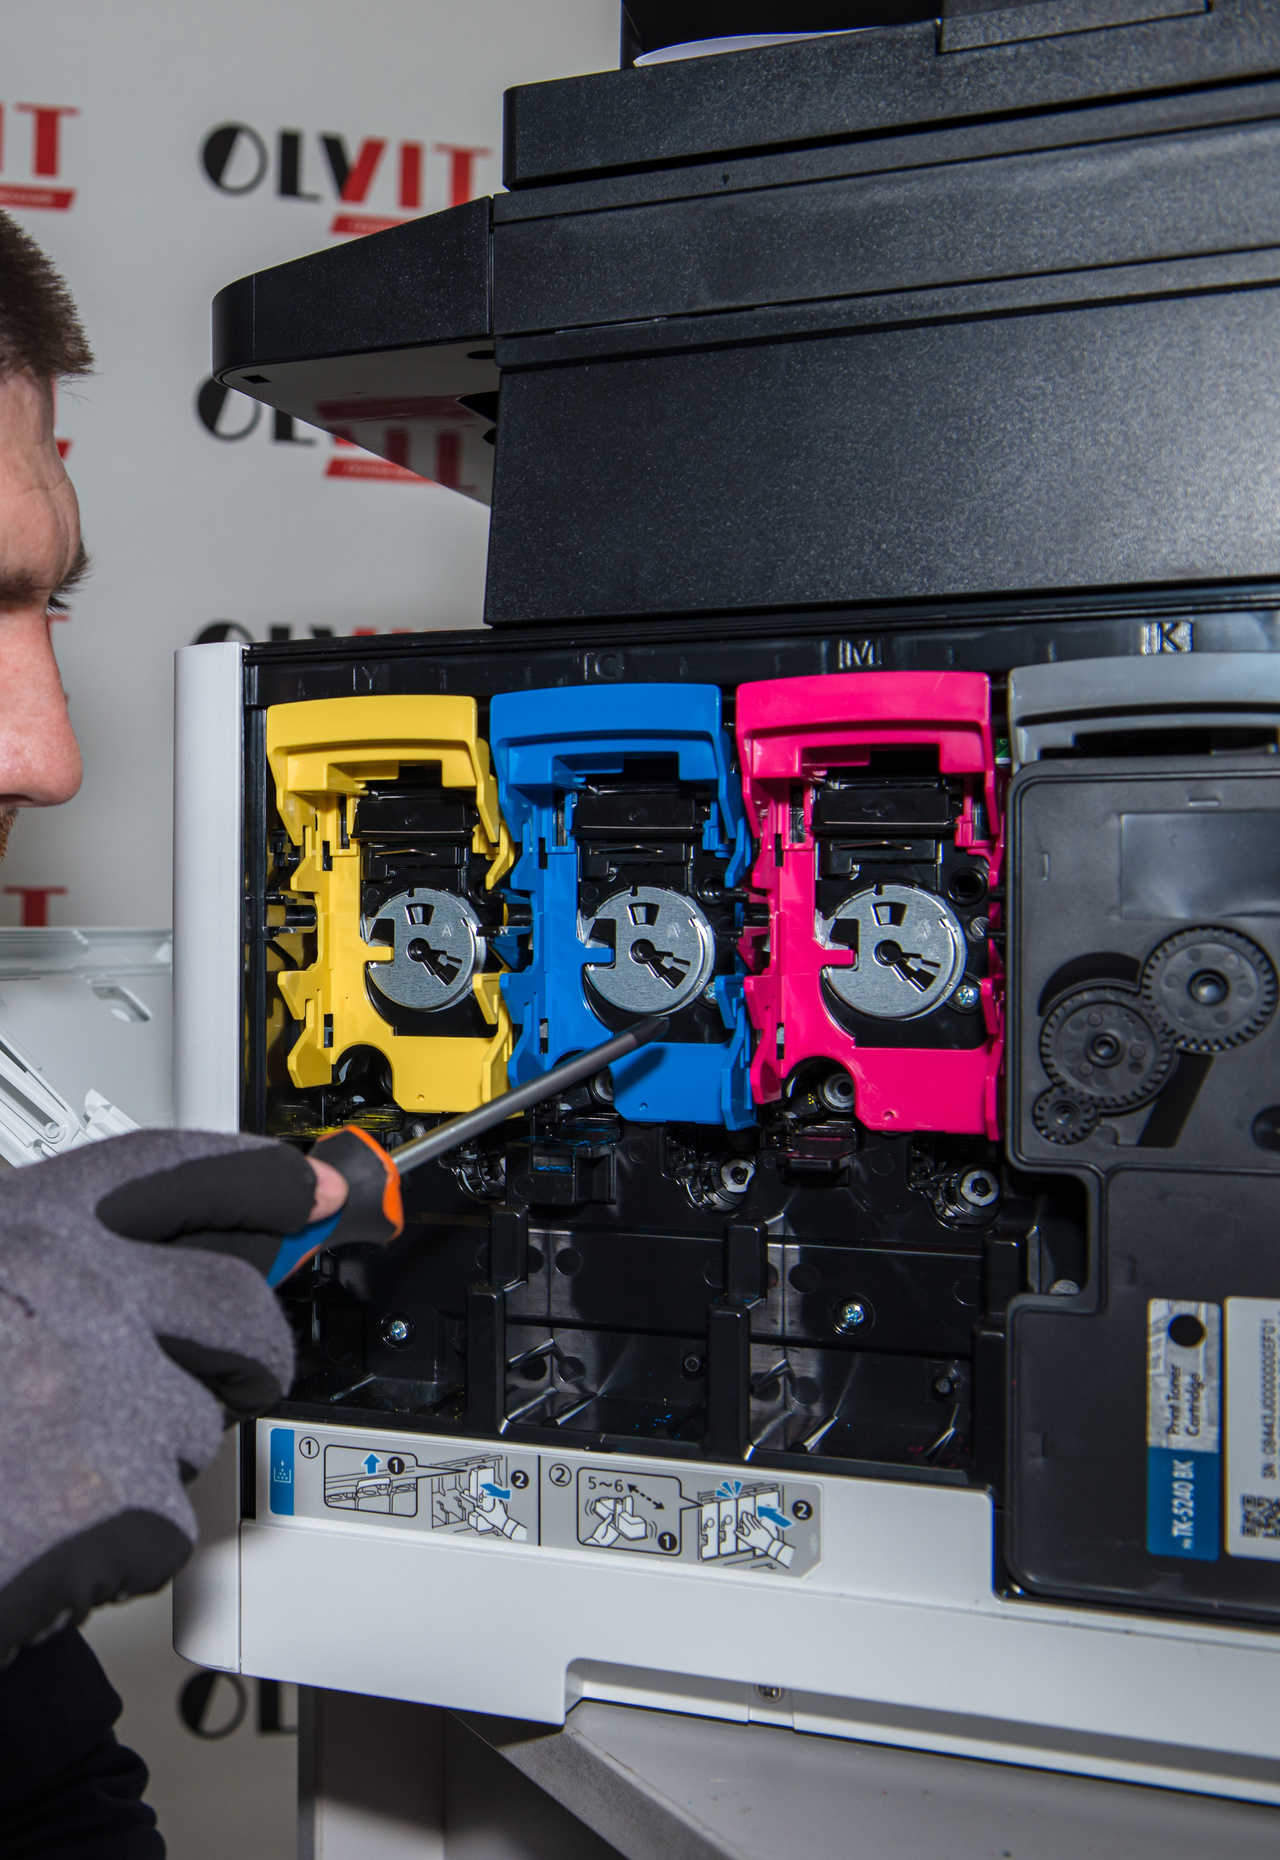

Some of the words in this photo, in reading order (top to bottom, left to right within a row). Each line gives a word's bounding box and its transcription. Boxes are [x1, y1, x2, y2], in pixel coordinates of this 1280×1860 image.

[201, 121, 491, 211] OLVIT
[1167, 1364, 1182, 1402] Toner
[1186, 1373, 1205, 1437] Cartridge
[1167, 1405, 1180, 1436] Print
[1172, 1459, 1194, 1480] BK
[1172, 1481, 1194, 1538] TK-5240
